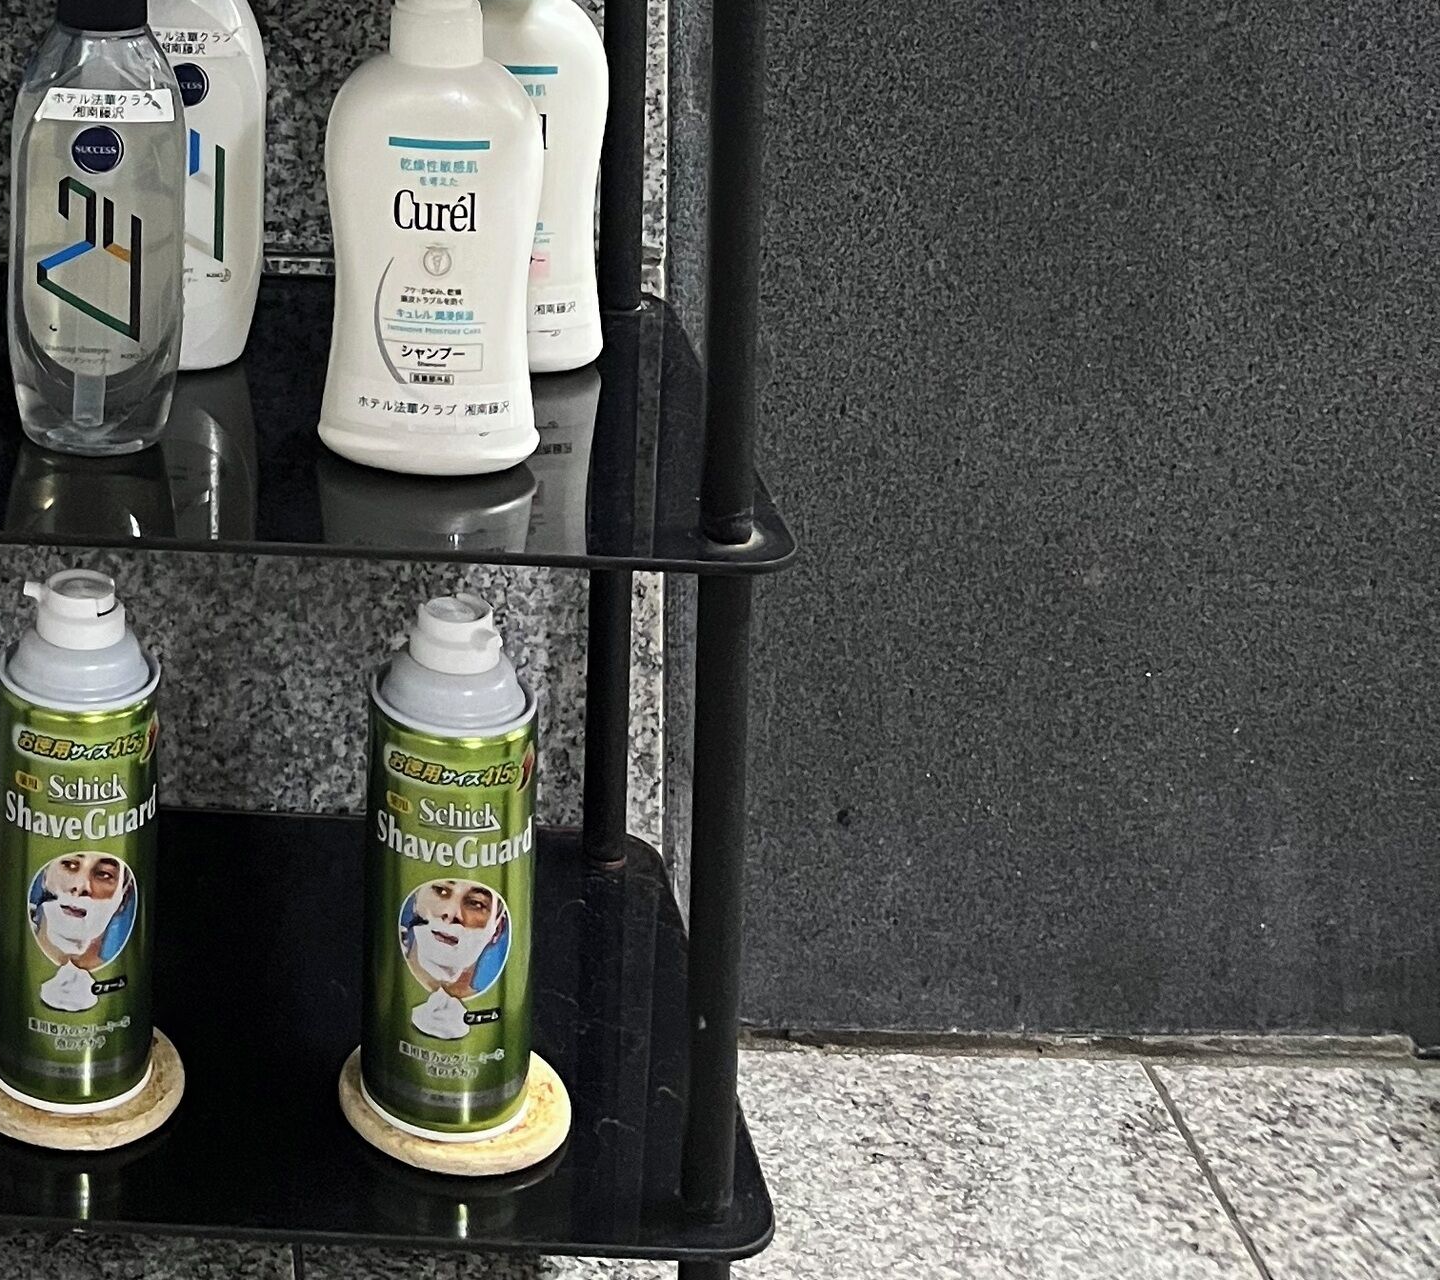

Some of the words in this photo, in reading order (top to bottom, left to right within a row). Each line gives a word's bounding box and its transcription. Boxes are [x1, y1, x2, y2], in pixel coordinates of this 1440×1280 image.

[74, 145, 118, 155] SUCCESS
[400, 157, 479, 174] 乾燥性敏感肌
[393, 189, 477, 233] Curél
[396, 308, 433, 320] キュレル
[401, 344, 466, 360] シャンプー
[358, 396, 458, 416] ホテル法華クラブ
[47, 774, 128, 801] Schick
[5, 783, 157, 841] ShaveGuard
[418, 798, 502, 831] Schick
[377, 809, 534, 869] ShaveGuard
